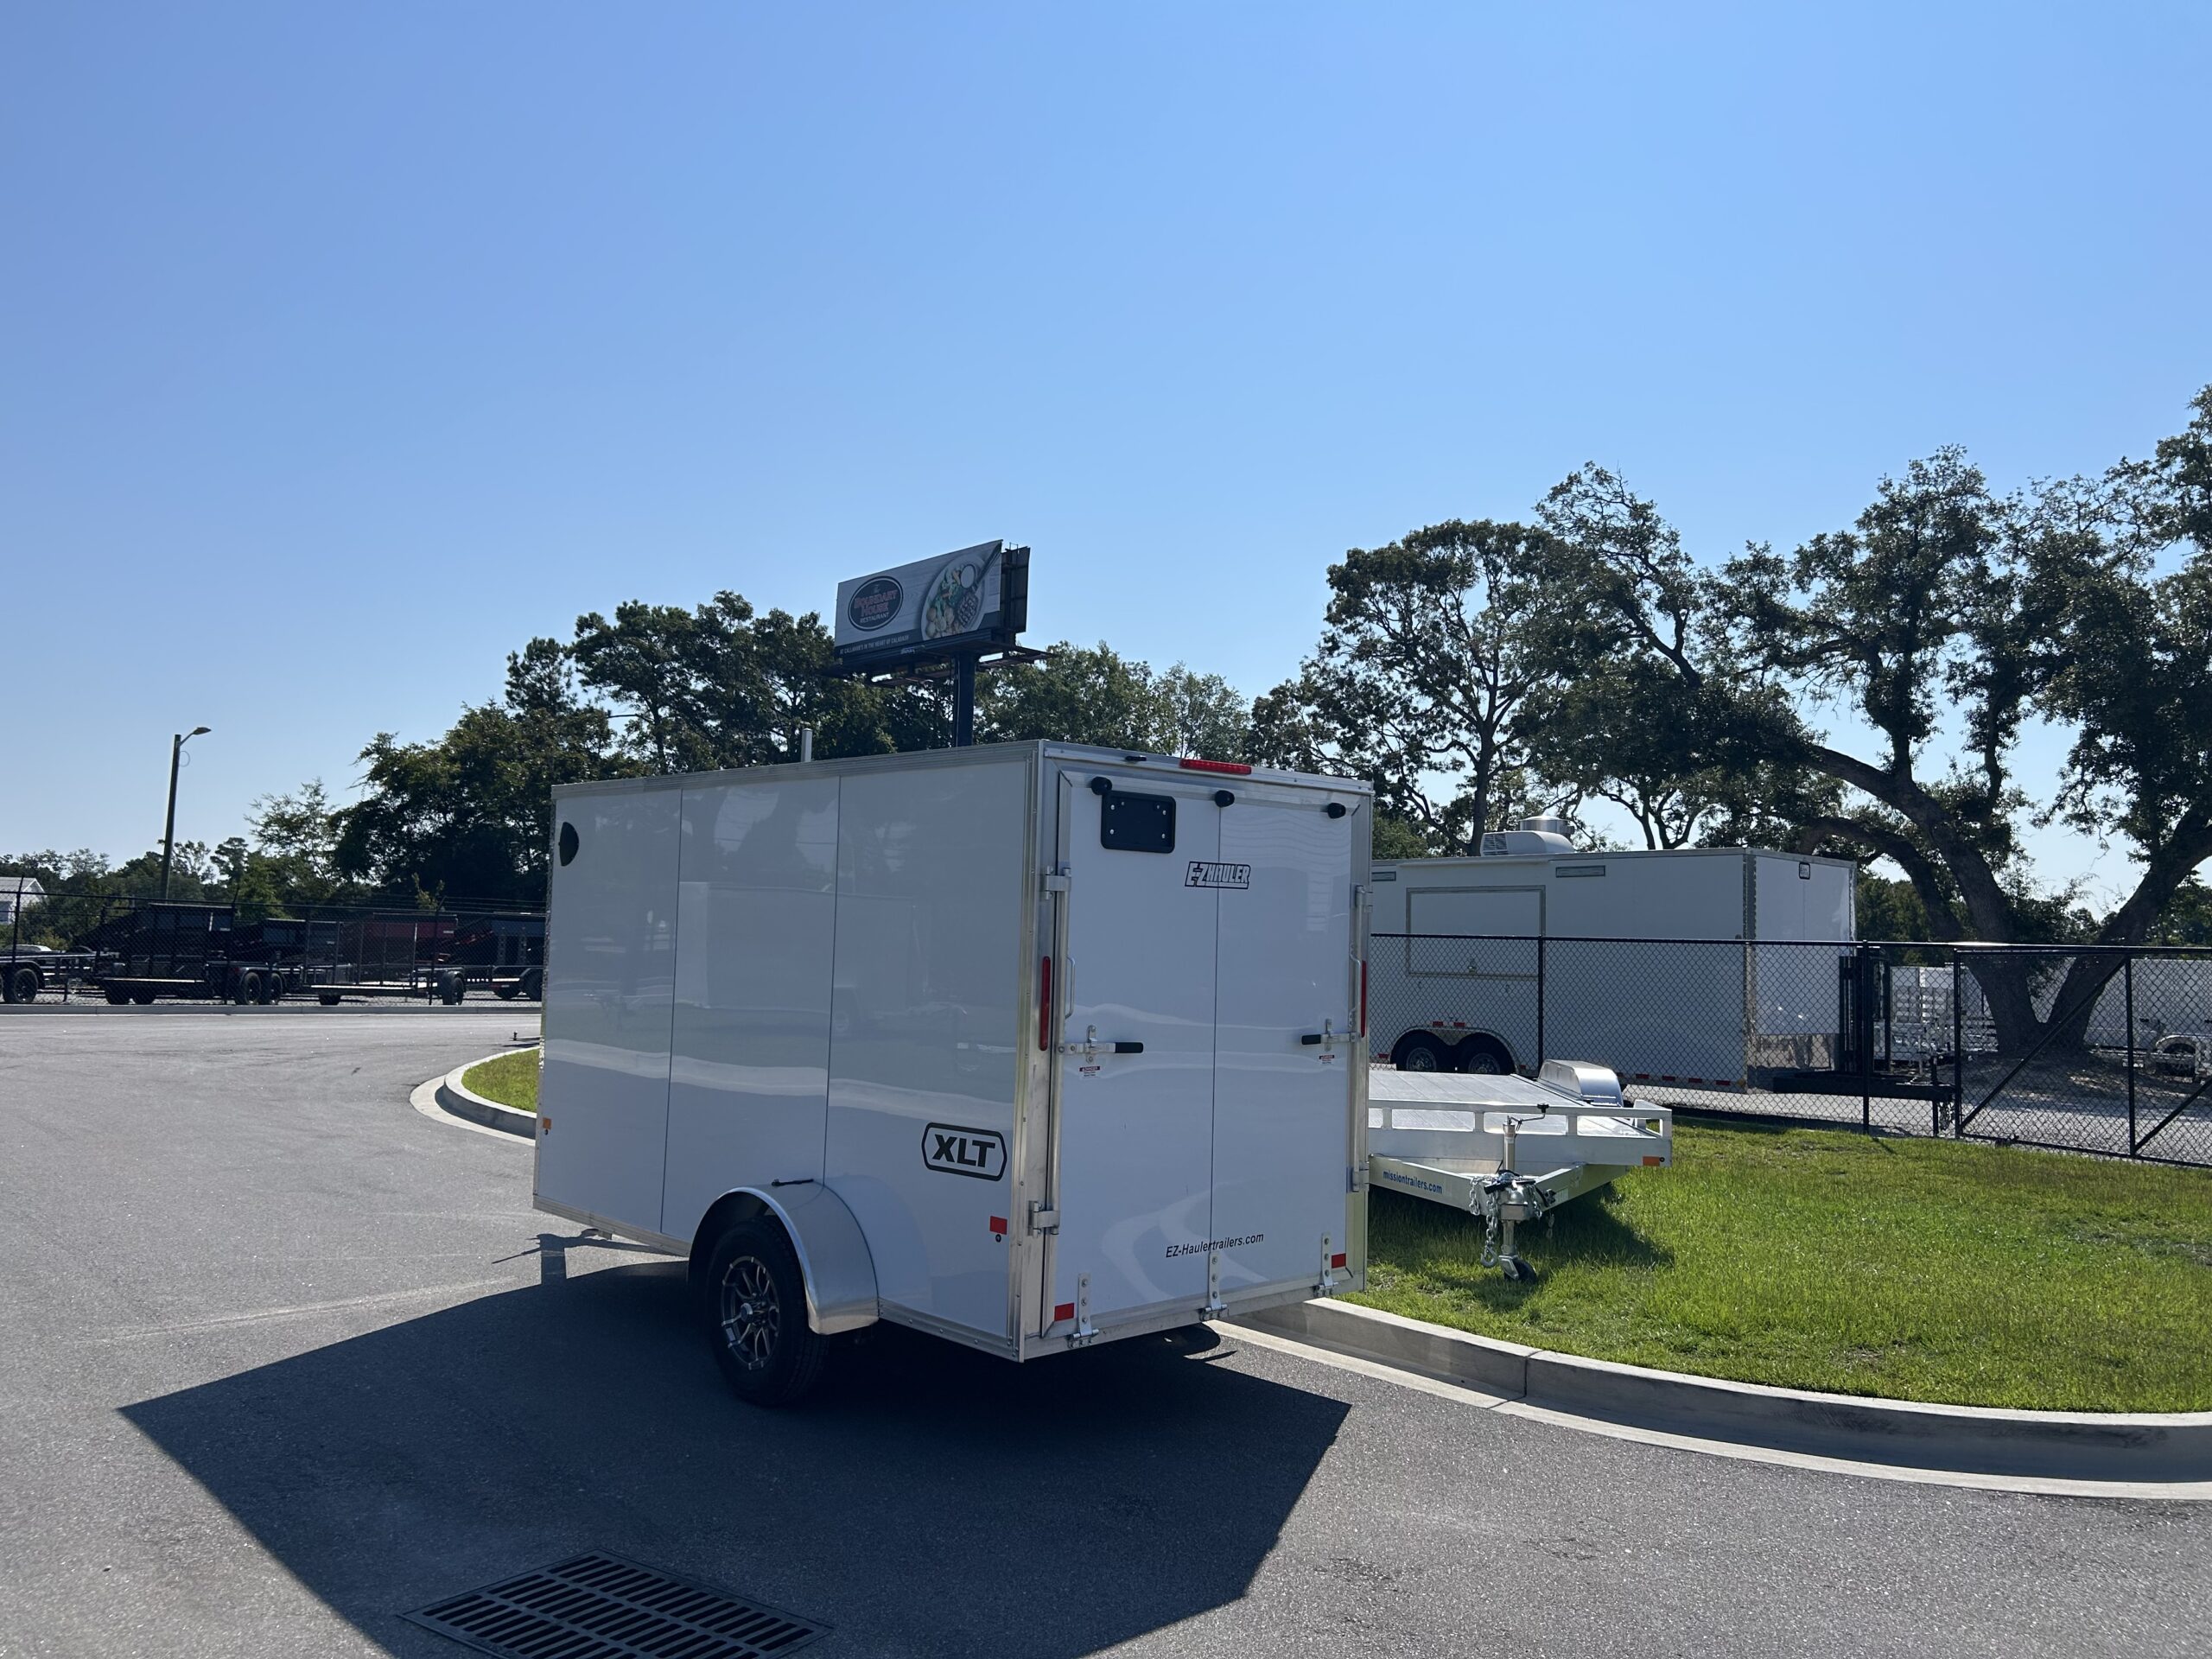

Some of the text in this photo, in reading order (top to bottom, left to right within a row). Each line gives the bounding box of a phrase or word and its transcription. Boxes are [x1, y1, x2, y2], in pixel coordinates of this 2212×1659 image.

[860, 612, 889, 623] RESTAURANT
[932, 1134, 995, 1167] XLT
[1382, 1170, 1442, 1194] missiontrailers.com
[1166, 1234, 1264, 1257] EZ-Haulertrailers.com
